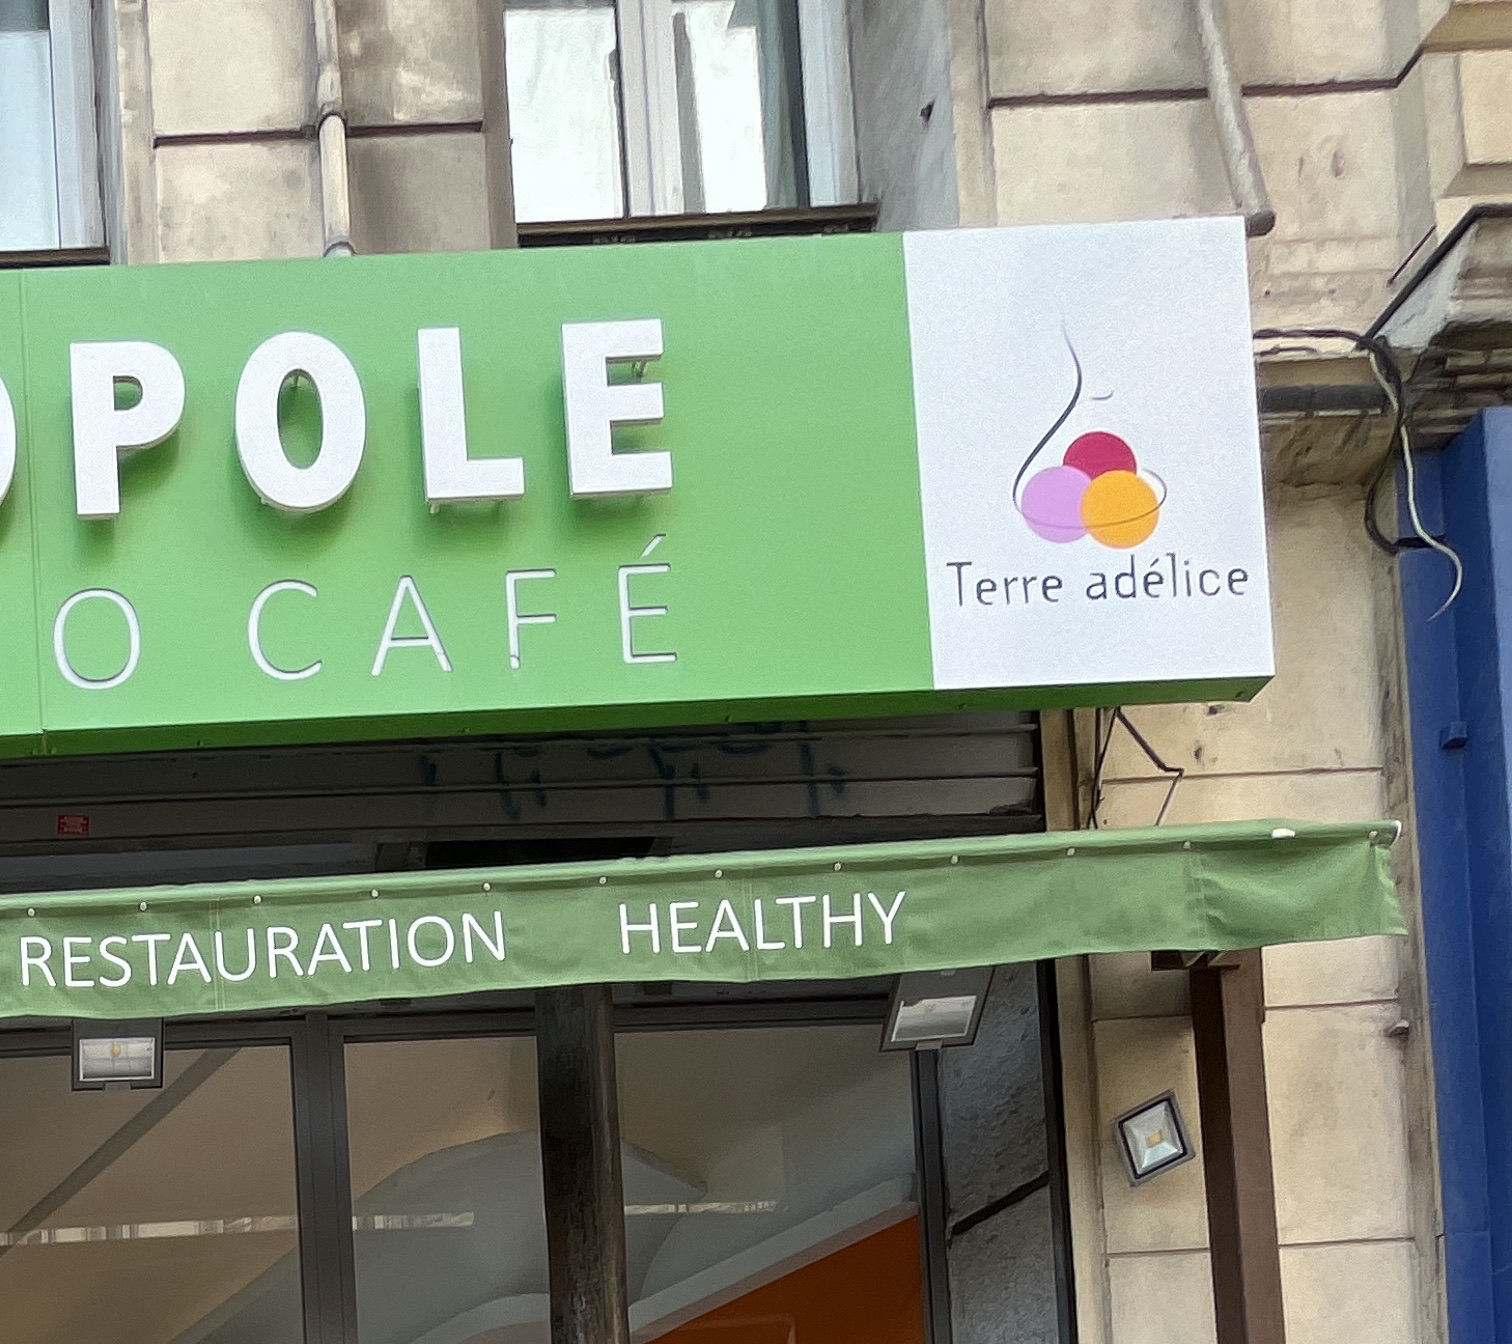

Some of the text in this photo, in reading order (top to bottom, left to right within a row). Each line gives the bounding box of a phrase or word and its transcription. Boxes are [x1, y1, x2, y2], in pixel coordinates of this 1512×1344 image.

[247, 533, 678, 680] CAFÉ
[946, 552, 1250, 606] Terre adélice
[18, 891, 906, 988] RESTAURATION HEALTHY
